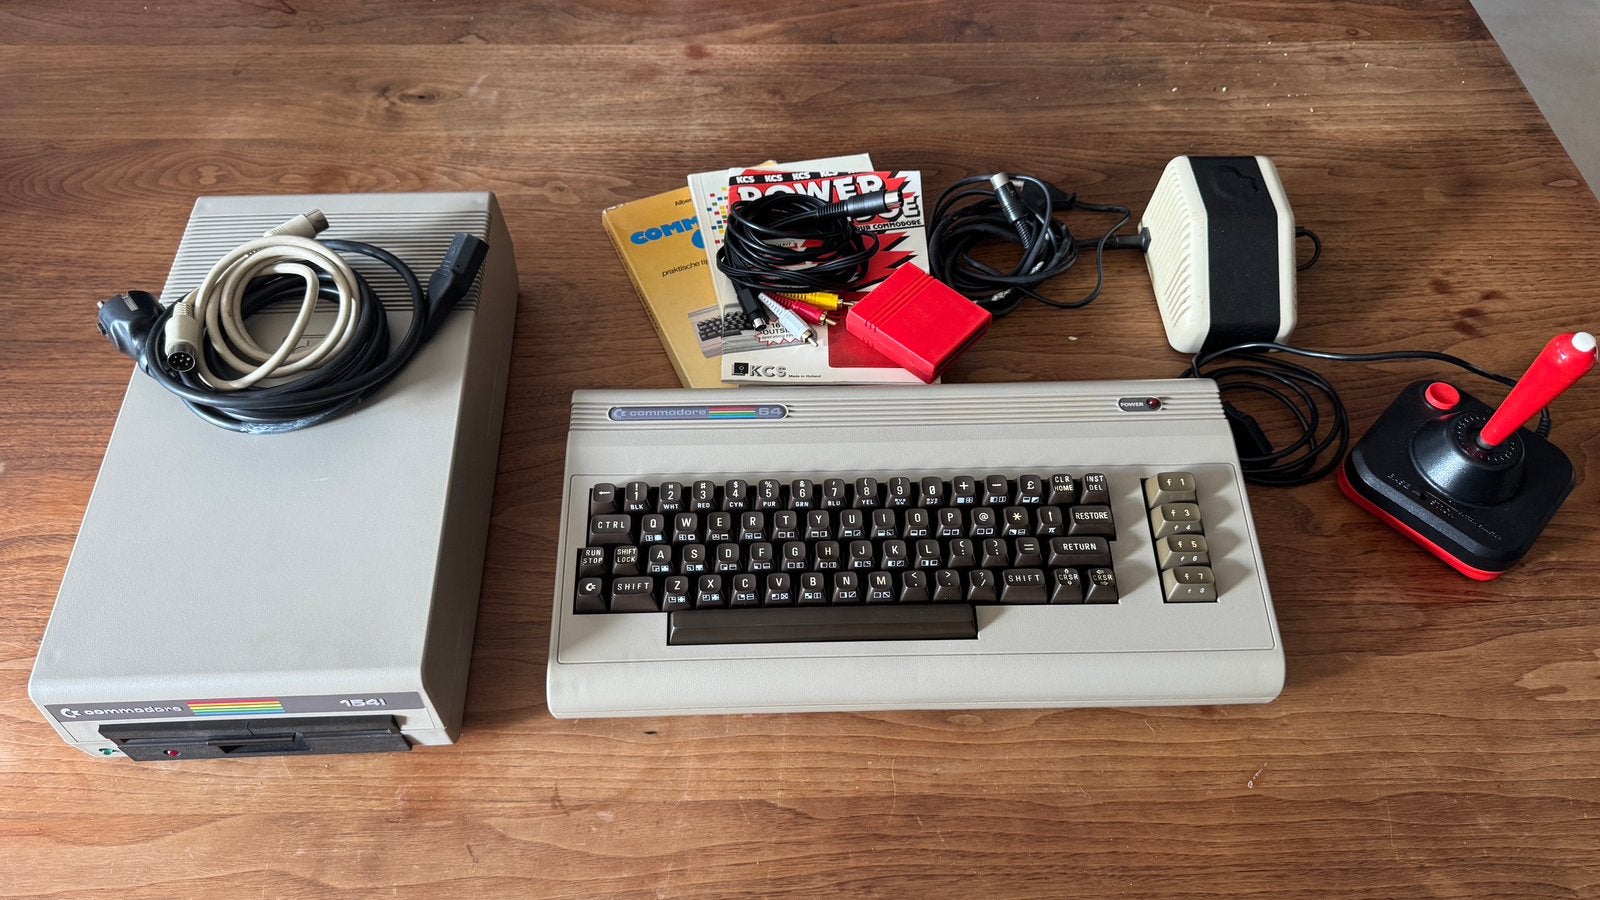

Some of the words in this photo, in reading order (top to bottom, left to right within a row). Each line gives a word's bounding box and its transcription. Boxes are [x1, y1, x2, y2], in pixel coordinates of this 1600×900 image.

[736, 176, 756, 184] KCS
[764, 174, 784, 183] KCS
[792, 172, 812, 181] KCS
[736, 174, 887, 202] POWER
[872, 218, 922, 230] COMMODORE
[662, 262, 700, 277] praktische
[750, 365, 787, 378] KCS
[629, 408, 706, 416] commodore
[758, 408, 783, 416] 64
[733, 489, 738, 497] 4
[766, 487, 771, 497] 5
[800, 489, 805, 497] 6
[832, 488, 837, 496] 7
[864, 487, 869, 495] 8
[897, 486, 903, 494] 9
[635, 492, 638, 500] 1
[668, 491, 673, 499] 2
[701, 491, 706, 499] 3
[750, 517, 756, 525] R
[783, 516, 789, 524] T
[816, 515, 821, 523] Y
[849, 515, 855, 523] U
[915, 513, 920, 522] O
[948, 513, 953, 521] P
[651, 519, 656, 528] Q
[682, 518, 691, 527] W
[717, 518, 722, 526] E
[726, 549, 731, 557] D
[759, 548, 764, 556] F
[792, 547, 798, 556] G
[825, 547, 831, 555] H
[859, 546, 864, 554] J
[892, 546, 898, 554] K
[926, 545, 931, 553] L
[691, 550, 697, 558] S
[708, 580, 713, 588] X
[742, 579, 748, 587] C
[776, 578, 782, 586] V
[810, 577, 816, 586] B
[843, 577, 850, 585] N
[877, 576, 886, 584] M
[675, 581, 680, 589] Z
[84, 706, 183, 714] commodore
